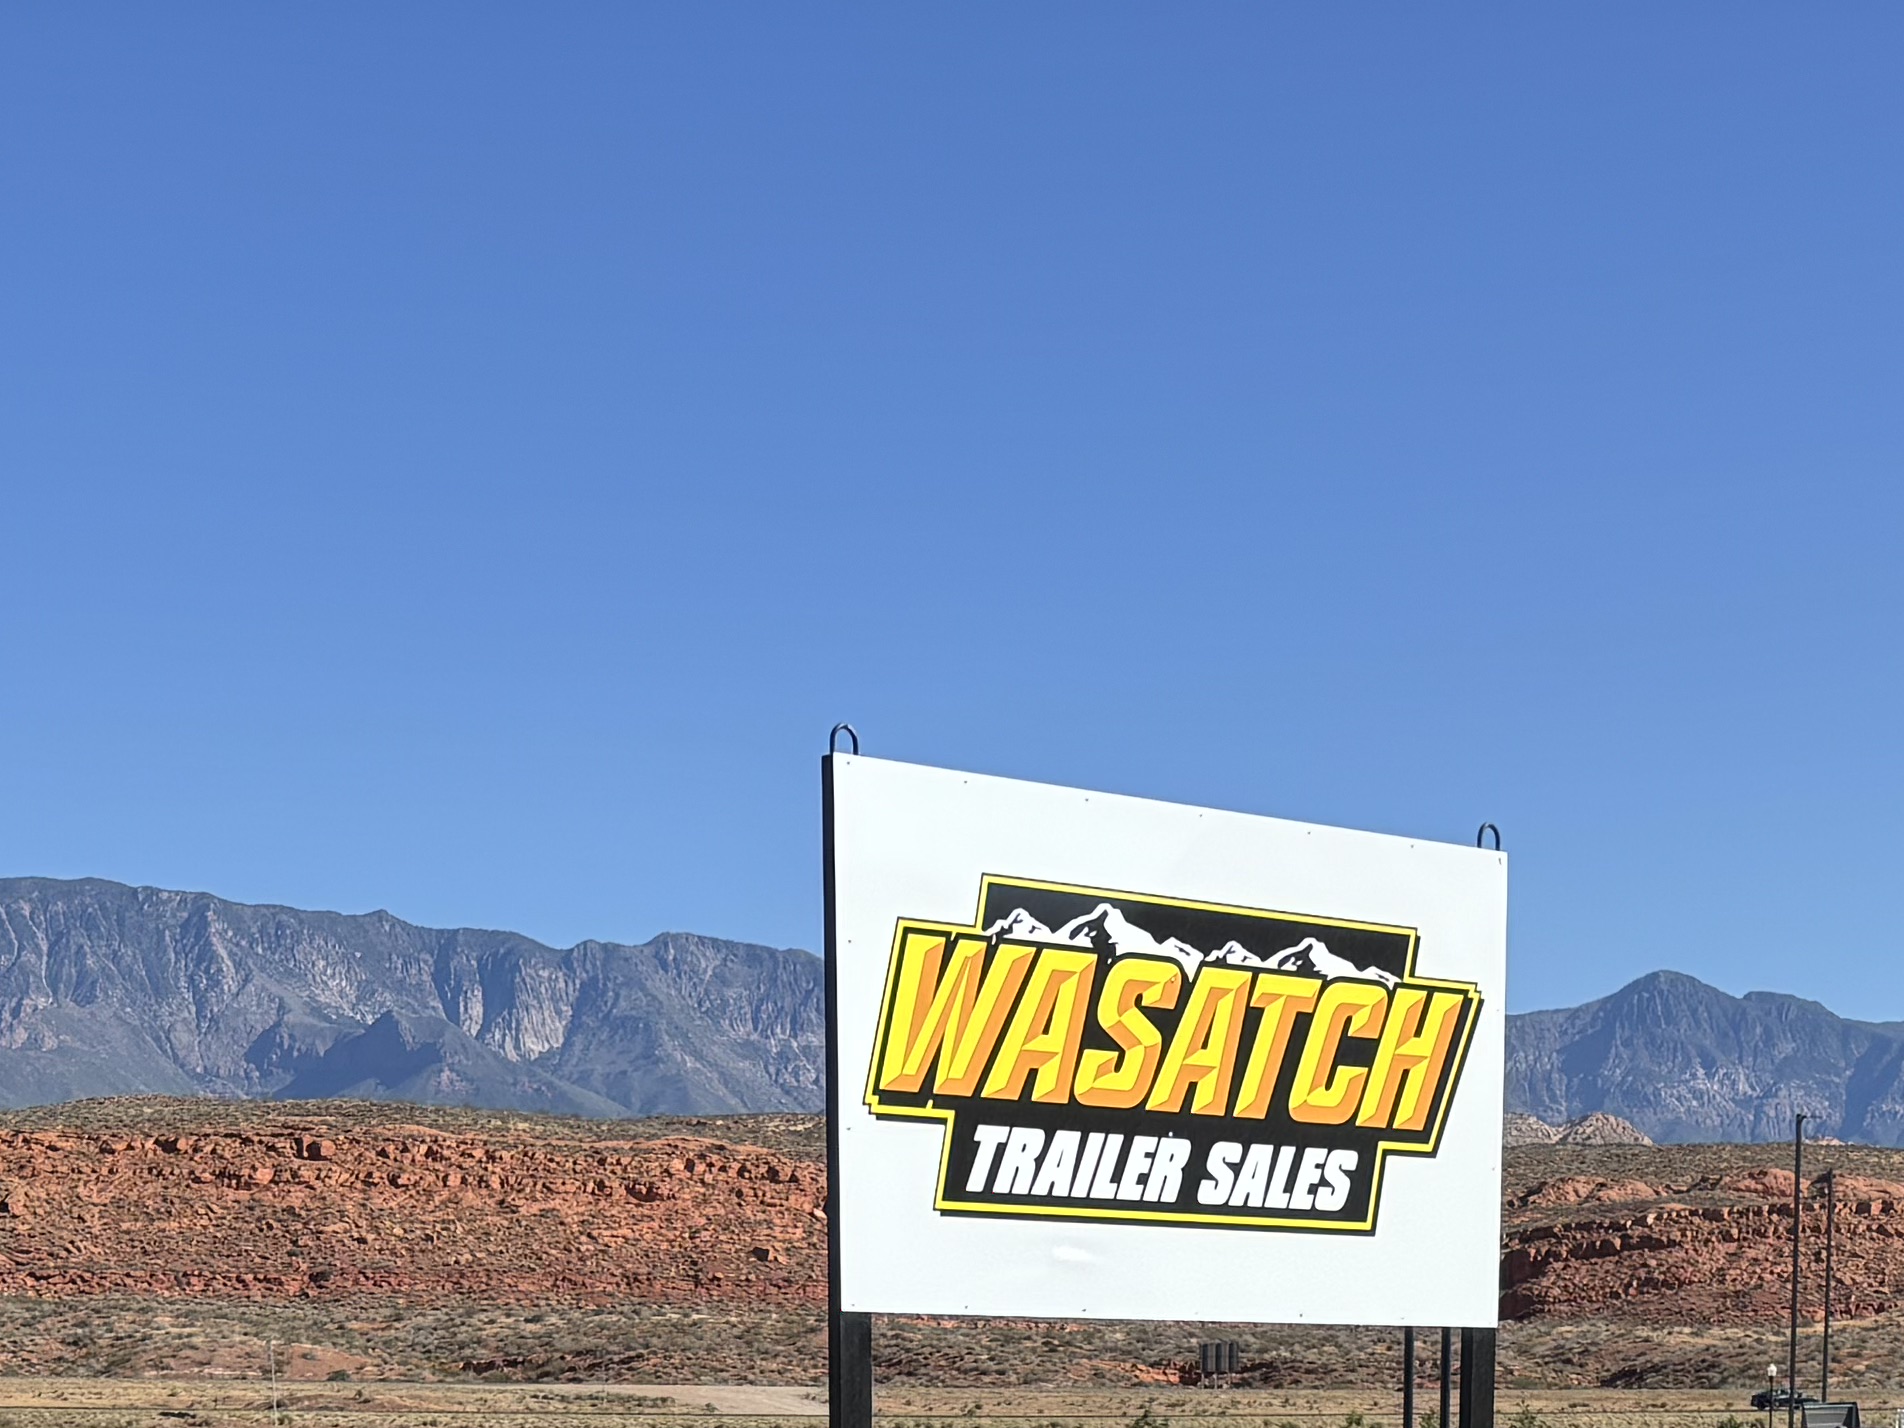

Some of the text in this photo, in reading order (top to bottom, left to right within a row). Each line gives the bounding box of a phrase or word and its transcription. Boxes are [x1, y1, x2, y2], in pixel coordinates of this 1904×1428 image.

[879, 931, 1464, 1131] WASATCH
[964, 1125, 1360, 1213] TRAILER SALES
